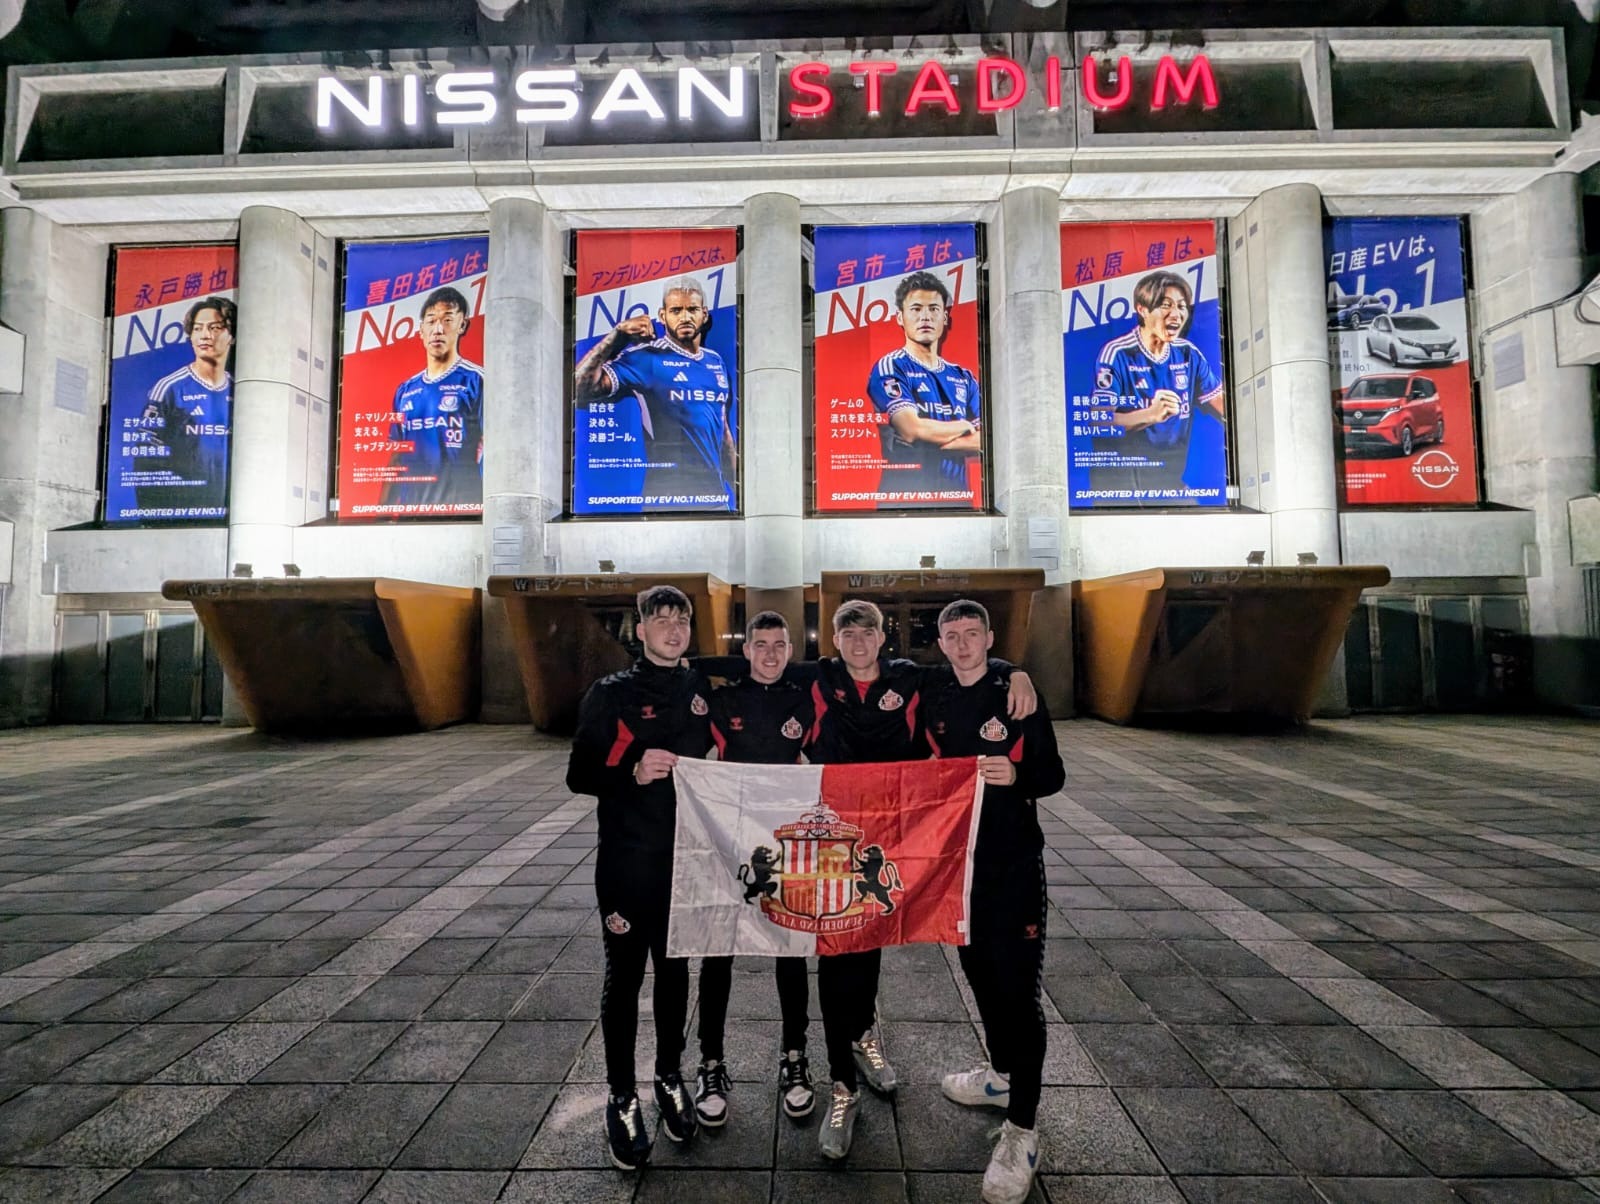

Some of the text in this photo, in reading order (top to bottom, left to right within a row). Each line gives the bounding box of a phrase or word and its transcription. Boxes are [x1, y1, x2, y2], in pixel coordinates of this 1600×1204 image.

[316, 55, 1218, 128] NISSAN STADIUM
[1330, 235, 1434, 276] 日産EVは、
[367, 251, 487, 306] 喜田拓也は、
[589, 402, 615, 413] 試合を
[830, 398, 864, 409] ゲームの
[830, 413, 887, 424] 流れを変える、
[1073, 411, 1112, 421] 走り切る、
[123, 417, 165, 427] 左サイドを
[588, 417, 619, 428] 決める、
[446, 430, 462, 442] 90
[831, 428, 877, 438] スプリント。
[1073, 425, 1122, 436] 熱いハート。
[588, 431, 636, 443] 決勝ゴール。
[354, 441, 414, 452] キャプテンシー。
[1411, 465, 1460, 473] NISSAN
[831, 492, 887, 500] SUPPORTED
[888, 492, 902, 500] BY
[917, 491, 939, 499] NO.1
[939, 491, 974, 499] NISSAN
[1075, 490, 1132, 498] SUPPORTED
[1133, 490, 1147, 498] BY
[1184, 489, 1219, 497] NISSAN
[588, 496, 644, 504] SUPPORTED
[644, 496, 658, 504] BY
[673, 495, 694, 503] NO.1
[694, 495, 729, 503] NISSAN
[120, 508, 173, 517] SUPPORTED
[174, 508, 188, 516] BY
[188, 507, 201, 516] EV
[202, 507, 221, 515] NO.1
[352, 505, 405, 513] SUPPORTED
[406, 504, 418, 512] BY
[419, 504, 432, 512] EV
[432, 504, 452, 512] NO.1
[514, 579, 527, 590] W
[535, 577, 594, 591] 西ゲート
[849, 575, 862, 587] W
[870, 572, 930, 587] 西ゲート
